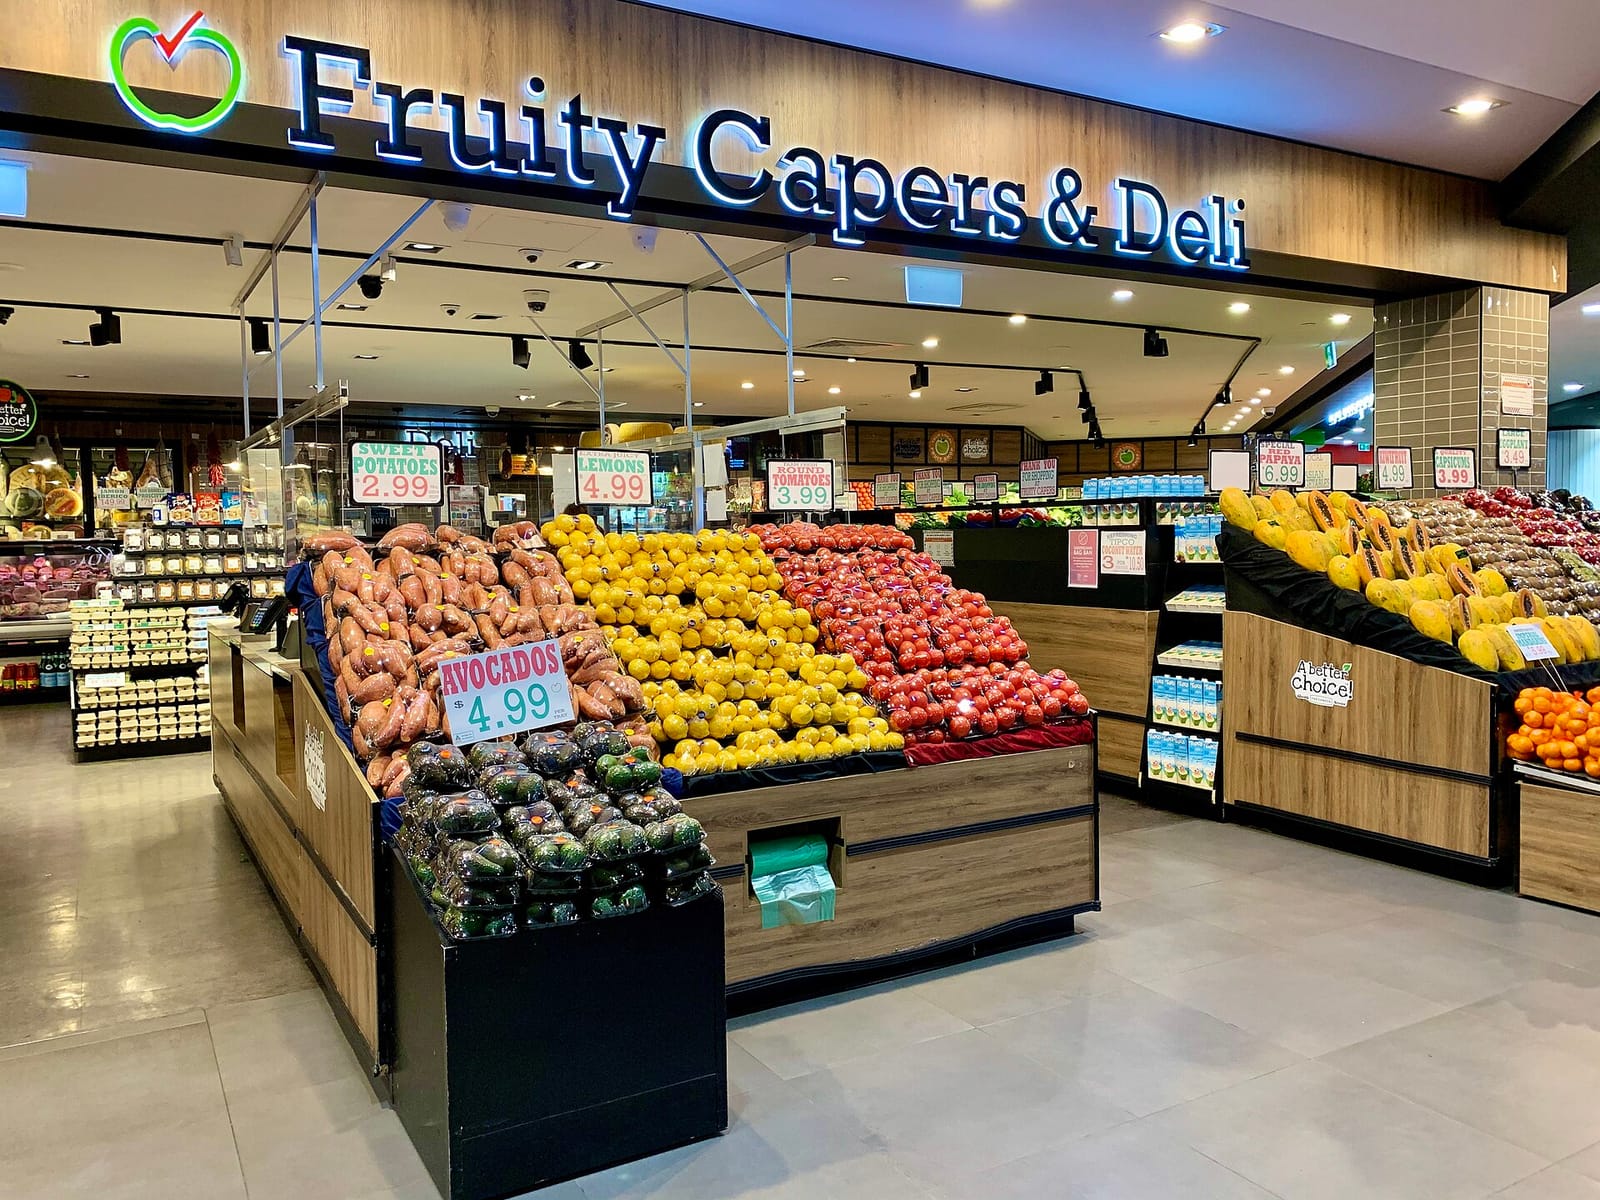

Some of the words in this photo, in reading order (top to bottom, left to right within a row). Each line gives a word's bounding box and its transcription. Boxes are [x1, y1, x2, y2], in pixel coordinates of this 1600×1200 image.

[284, 35, 666, 218] Fruity
[693, 109, 1026, 244] Capers
[1044, 167, 1099, 248] &
[1113, 177, 1251, 269] Deli
[359, 443, 426, 456] SWEET
[1260, 441, 1295, 449] SPECIAL
[577, 457, 645, 473] LEMONS
[1260, 455, 1302, 465] PAPAYA
[1436, 456, 1470, 468] CAPSICUMS
[1504, 450, 1525, 464] 3.49
[353, 457, 438, 475] POTATOES
[1265, 465, 1298, 482] 6.99
[1382, 465, 1405, 482] 4.99
[772, 474, 830, 486] TOMATOES
[1438, 469, 1468, 483] 3.99
[362, 475, 428, 498] 2.99
[583, 473, 643, 500] 4.99
[777, 487, 827, 504] 3.99
[1103, 555, 1114, 569] 3
[441, 643, 559, 696] AVOCADOS
[1297, 660, 1307, 673] A
[1309, 662, 1348, 680] better
[468, 683, 550, 732] 4.99
